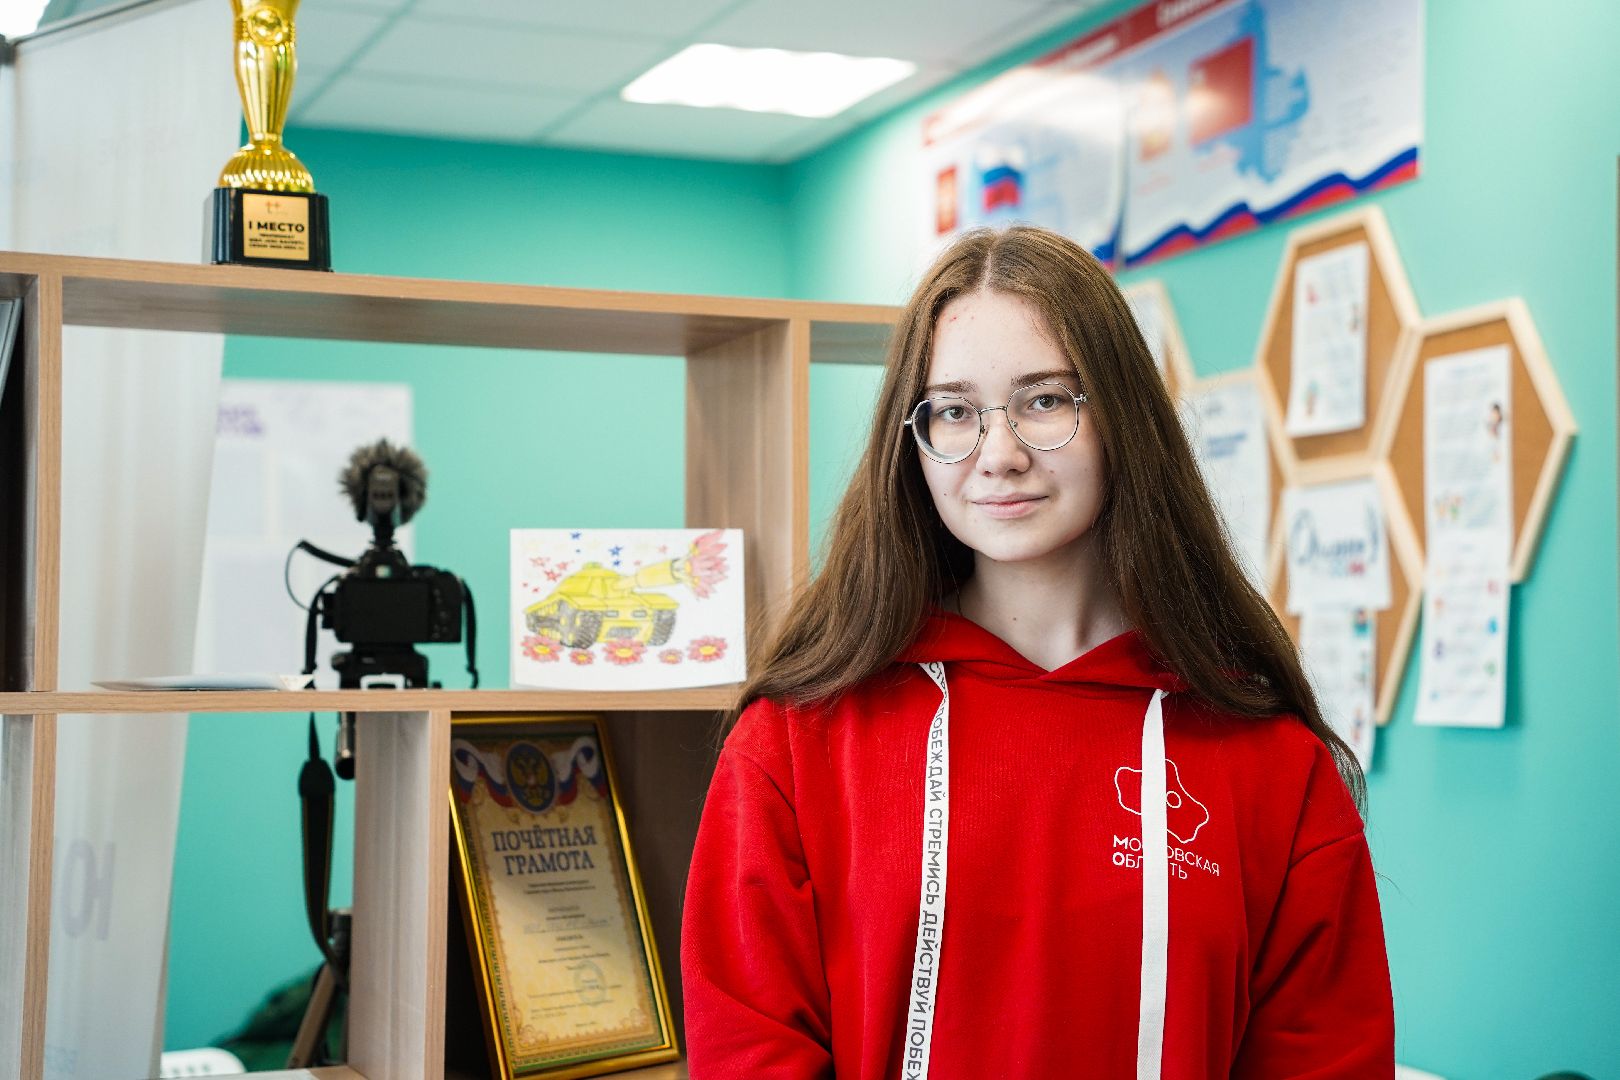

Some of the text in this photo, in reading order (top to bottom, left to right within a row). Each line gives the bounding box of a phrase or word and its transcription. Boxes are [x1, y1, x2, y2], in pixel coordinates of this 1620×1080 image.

[257, 222, 304, 232] МЕСТО
[928, 707, 947, 802] ПОБЕЖДАЙ
[492, 825, 597, 851] ПОЧЁТНАЯ
[504, 851, 594, 876] ГРАМОТА
[926, 808, 942, 905] СТРЕМИСЬ
[1112, 852, 1188, 880] ОБЛТЬ
[1113, 835, 1220, 877] МООВСКАЯ
[913, 910, 939, 1014] ДЕЙСТВУЙ
